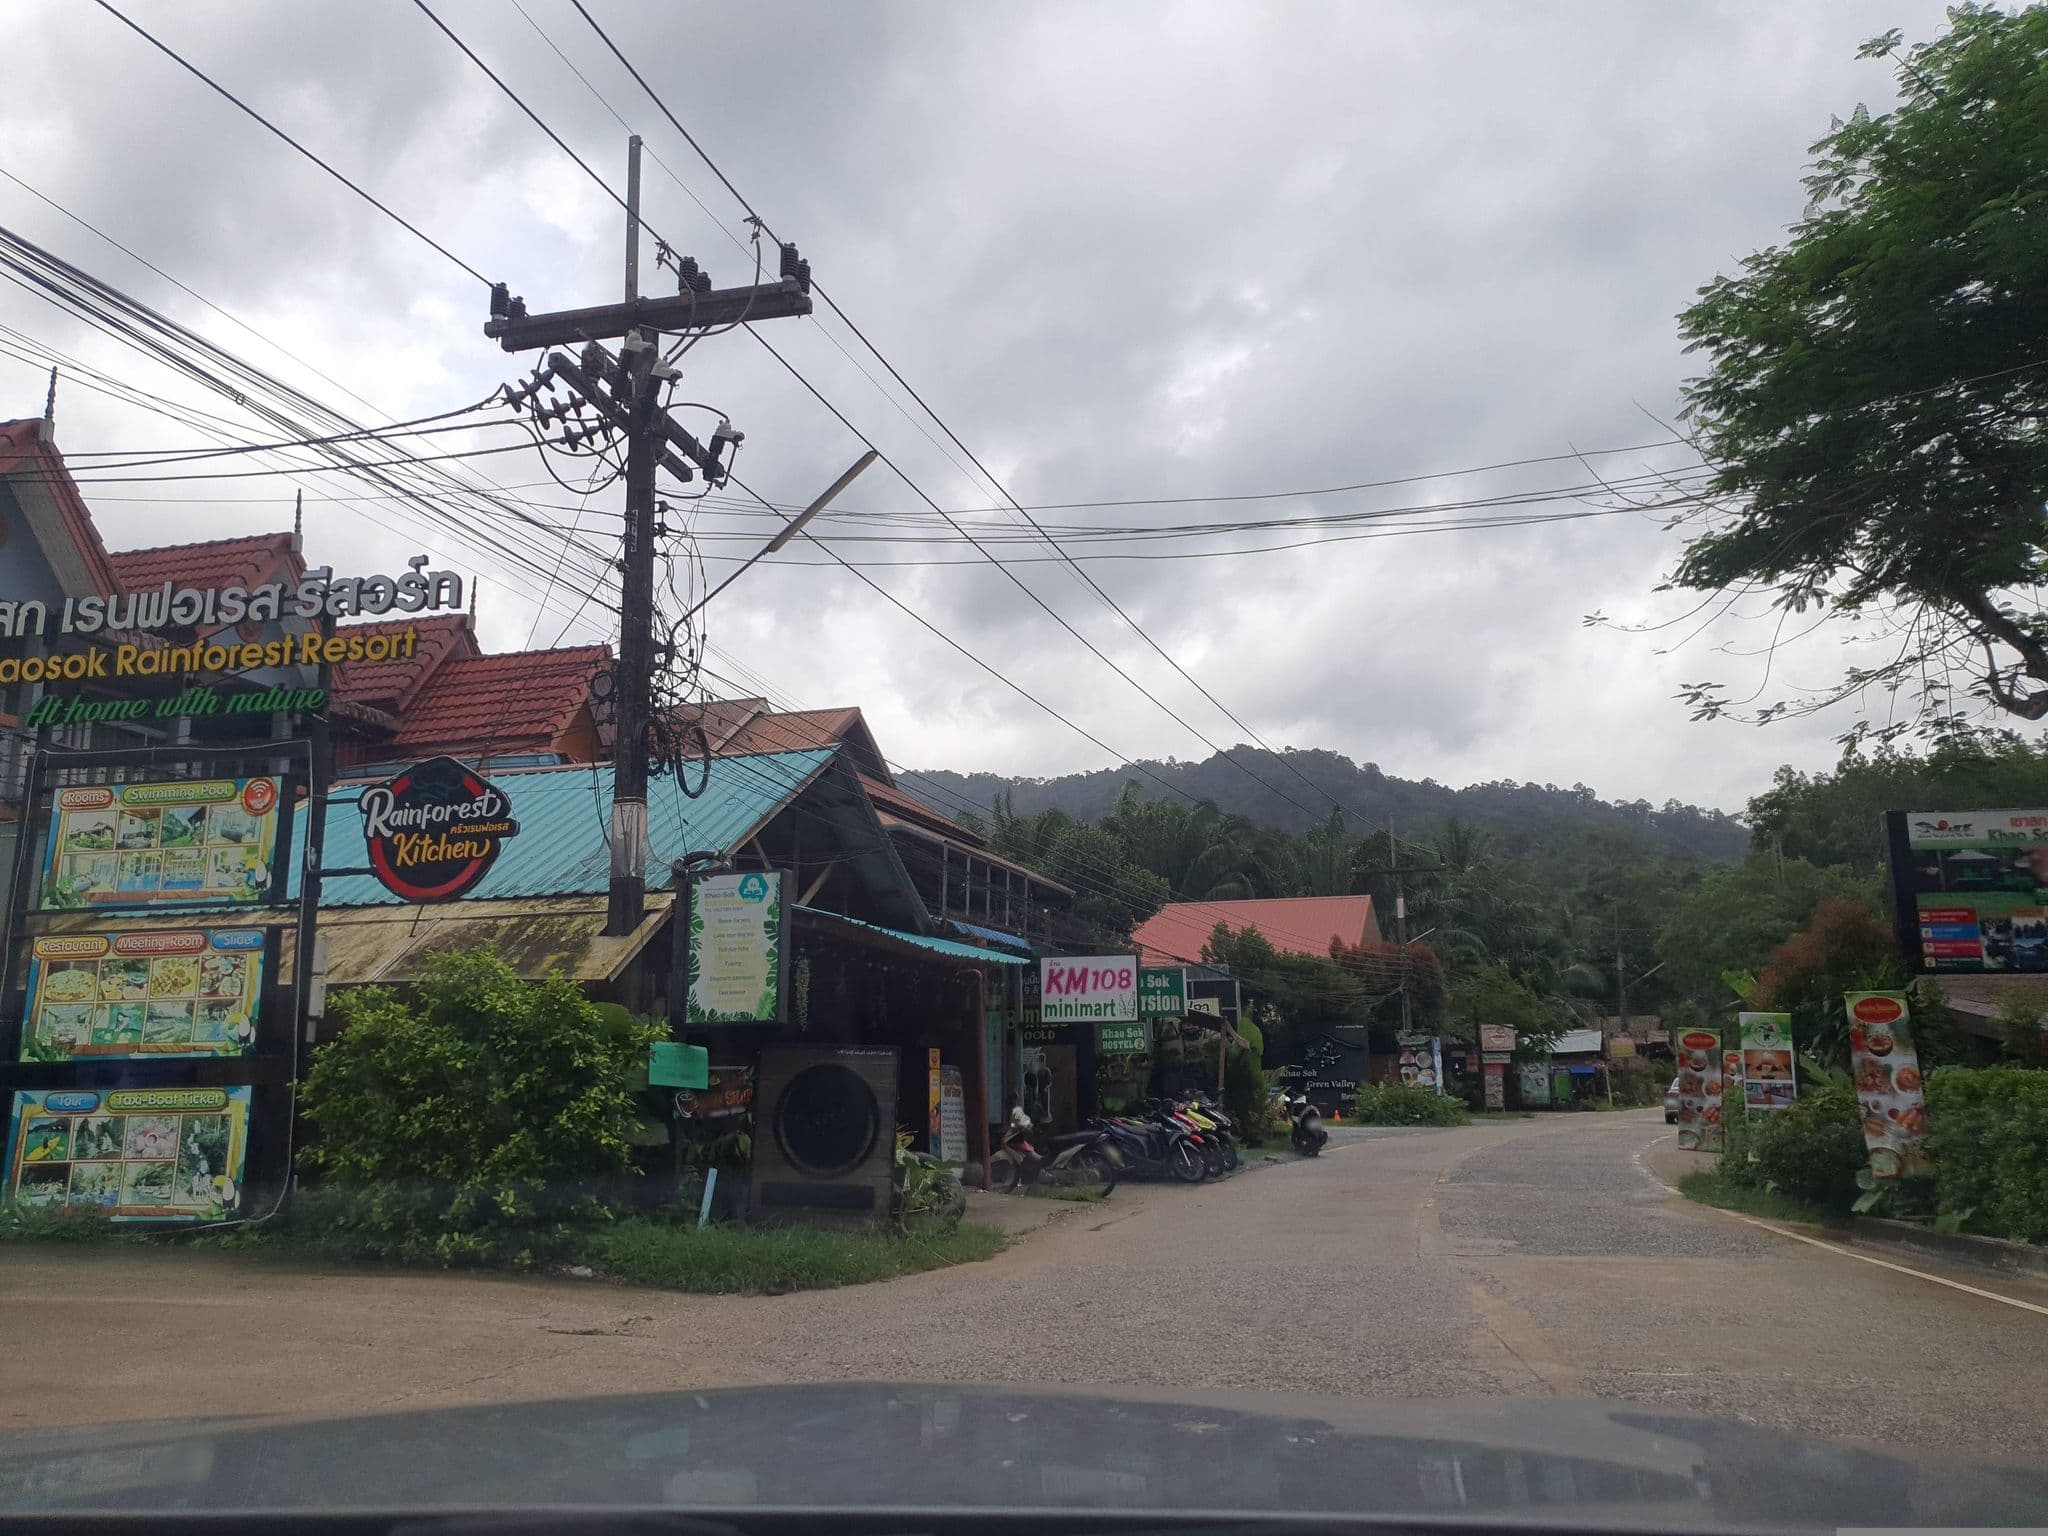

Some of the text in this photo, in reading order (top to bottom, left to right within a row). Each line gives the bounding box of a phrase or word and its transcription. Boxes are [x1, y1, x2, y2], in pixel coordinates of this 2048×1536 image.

[61, 579, 284, 634] เรนฟอเรส
[295, 554, 463, 620] รีสอร์ท
[116, 636, 297, 678] Rainforest
[301, 624, 417, 665] Resort
[24, 683, 329, 727] At home with nature
[67, 791, 105, 804] Rooms
[130, 783, 228, 802] Swimming Pool
[361, 787, 501, 838] Rainforest
[393, 832, 492, 868] Kitchen
[42, 939, 104, 952] Restaurant
[117, 936, 203, 951] Meeting Room
[1147, 974, 1170, 988] Sok
[1045, 998, 1117, 1018] minimart
[1102, 1027, 1144, 1039] Khao Sok
[1102, 1039, 1134, 1050] HOSTEL
[1306, 1079, 1357, 1090] Green Valley
[58, 1095, 84, 1107] Tour
[117, 1093, 220, 1107] Taxi-Boat Ticket
